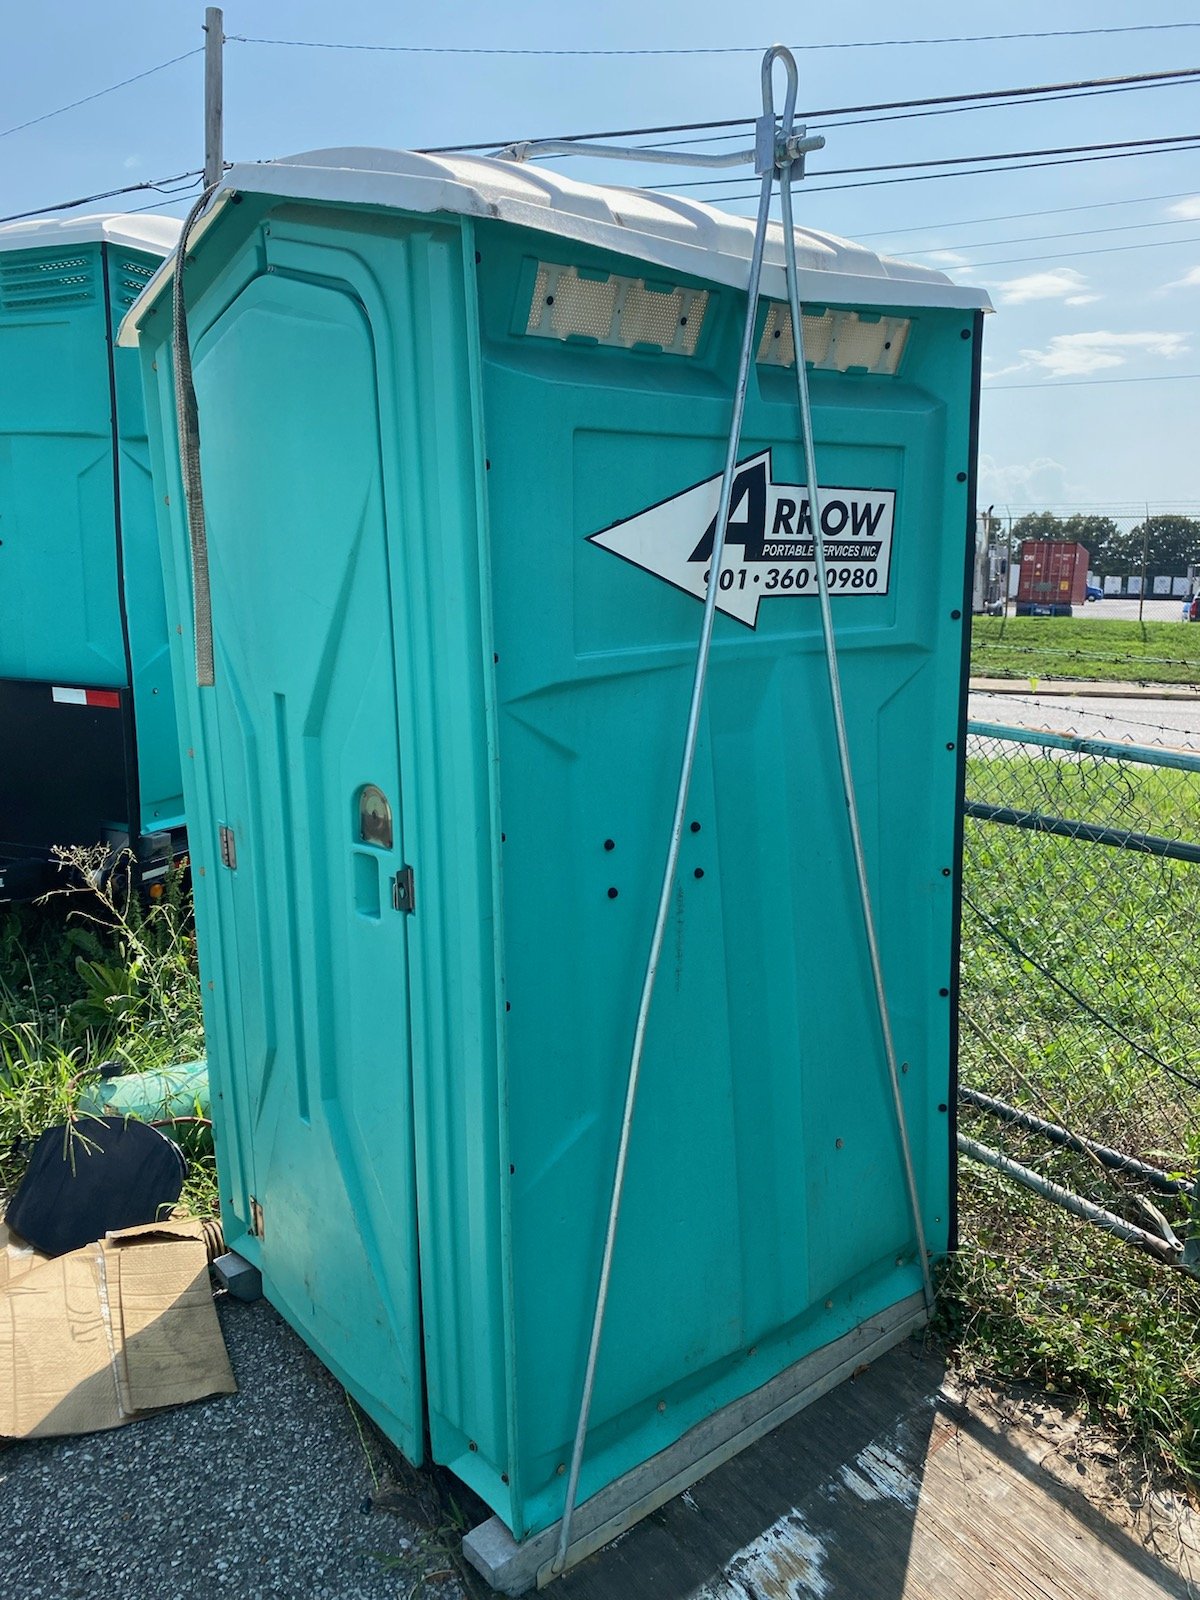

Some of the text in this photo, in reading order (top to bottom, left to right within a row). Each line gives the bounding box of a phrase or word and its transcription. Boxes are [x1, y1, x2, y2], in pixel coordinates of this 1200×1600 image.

[687, 461, 886, 562] ARROW
[762, 544, 878, 557] PORTABLE ERVICES INC.
